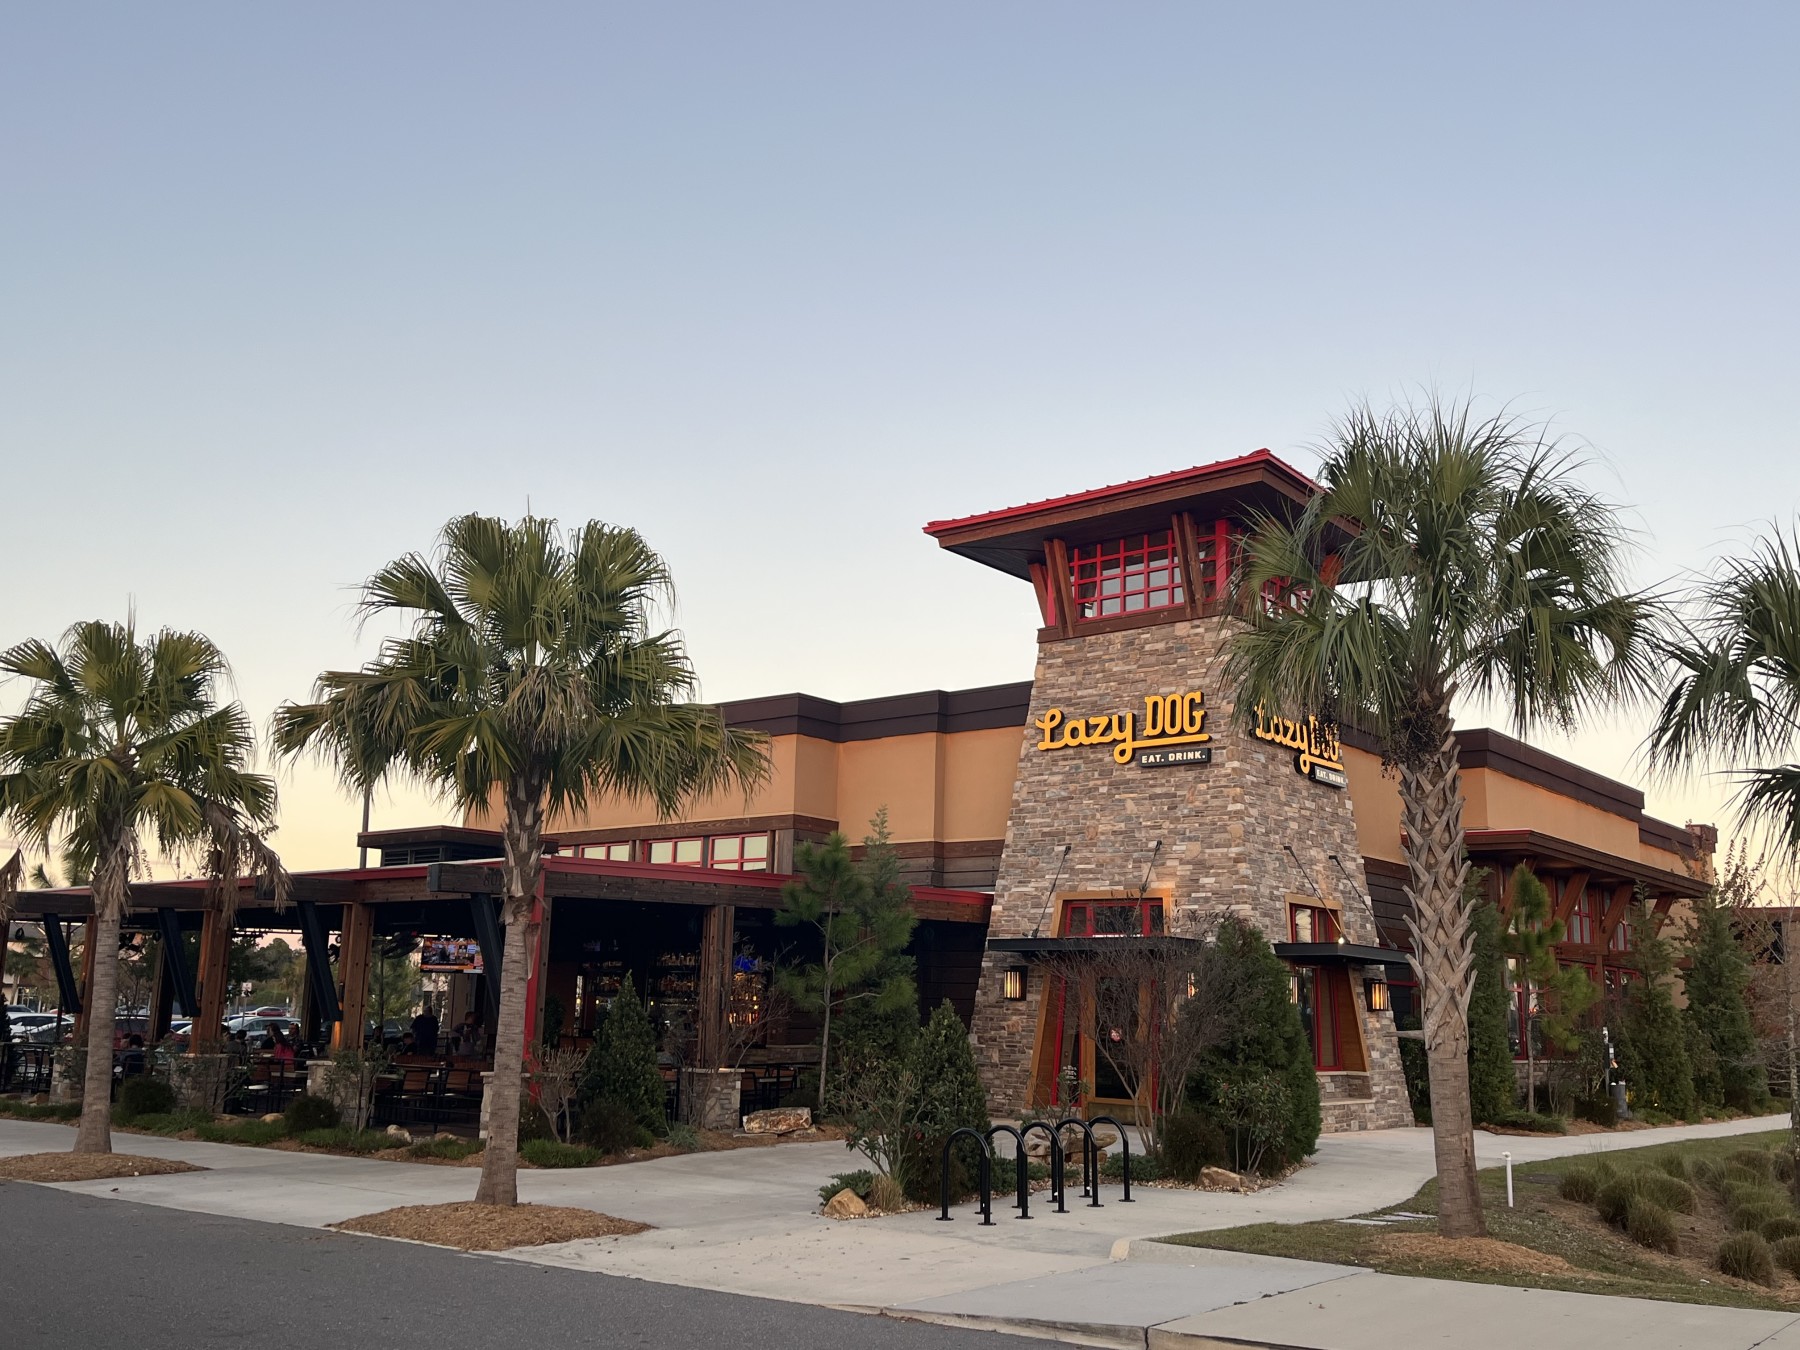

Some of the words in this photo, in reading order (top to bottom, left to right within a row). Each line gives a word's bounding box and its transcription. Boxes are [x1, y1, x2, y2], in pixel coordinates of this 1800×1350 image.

[1035, 707, 1134, 764] Lazy
[1143, 691, 1205, 737] DOG
[1141, 753, 1165, 764] EAT.
[1168, 750, 1207, 763] DRINK.
[1316, 769, 1328, 780] EAT.
